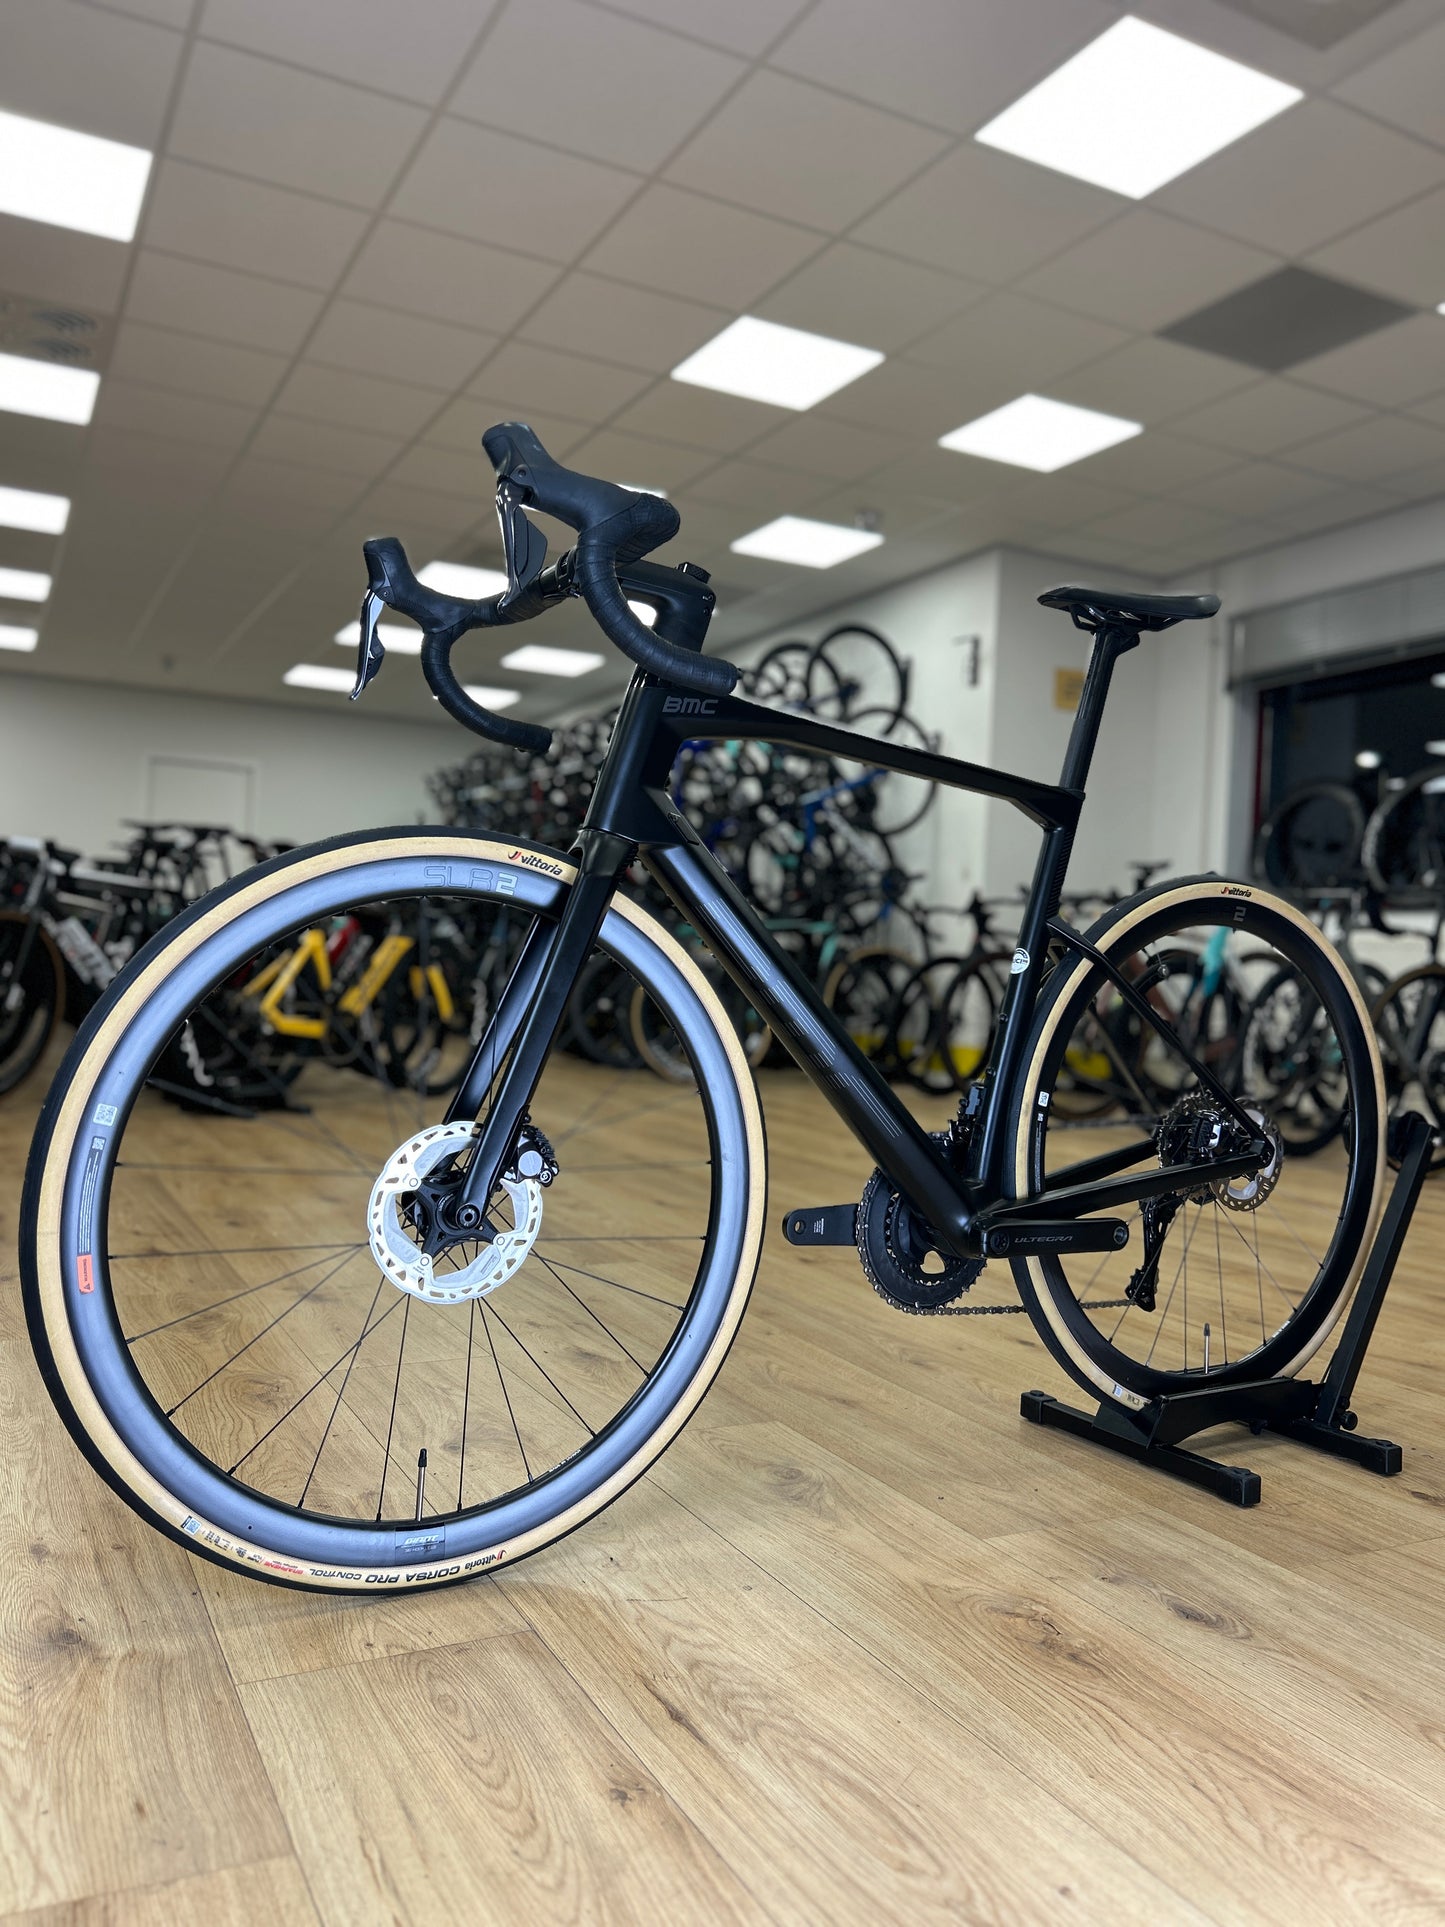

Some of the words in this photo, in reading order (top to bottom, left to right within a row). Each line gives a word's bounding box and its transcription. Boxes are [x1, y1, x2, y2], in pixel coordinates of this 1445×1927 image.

[662, 695, 719, 715] BMC
[520, 854, 564, 877] vittoria
[1228, 887, 1252, 898] vittoria
[1014, 1235, 1073, 1244] ULTEGRA
[464, 1553, 497, 1571] vittoria
[309, 1568, 363, 1581] CONTROL
[364, 1574, 401, 1584] PRO
[405, 1565, 461, 1583] CORSA
